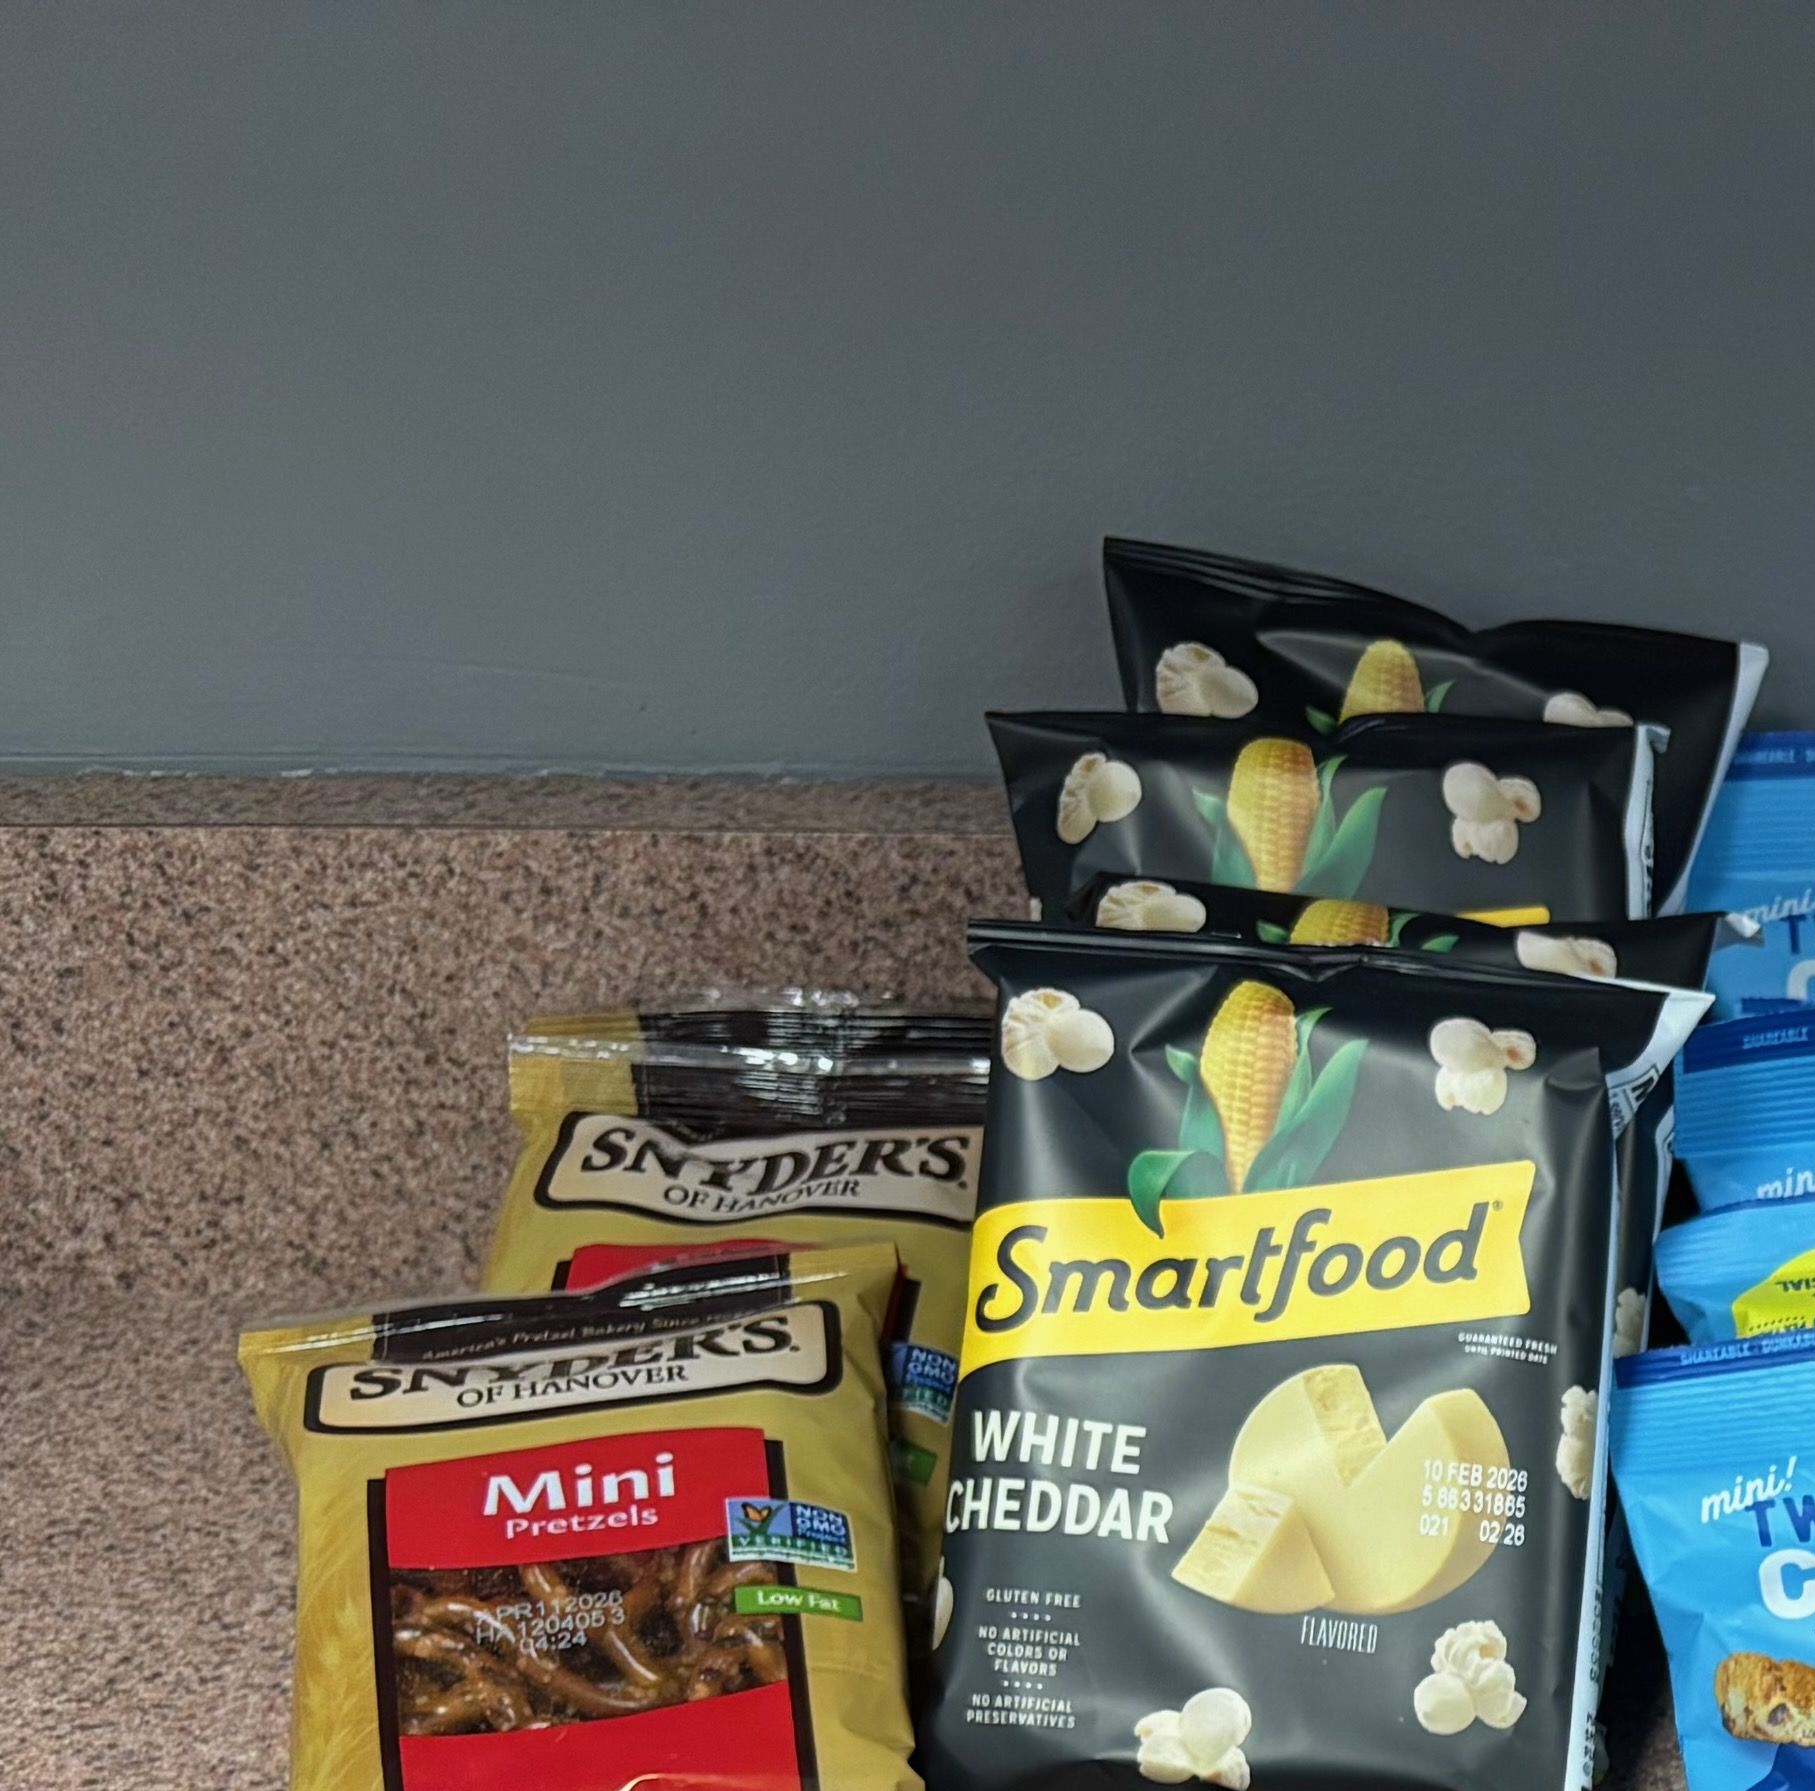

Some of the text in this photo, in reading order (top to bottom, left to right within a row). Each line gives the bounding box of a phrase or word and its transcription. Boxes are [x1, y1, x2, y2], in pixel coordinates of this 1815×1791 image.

[665, 1178, 860, 1212] OF HANOVER
[457, 1365, 689, 1408] OF HANOVER
[973, 1410, 1147, 1475] WHITE
[483, 1451, 675, 1516] Mini
[1701, 1456, 1797, 1525] mini!
[506, 1503, 658, 1539] Pretzels
[795, 1503, 841, 1523] NON
[945, 1479, 1174, 1544] CHEDDAR
[757, 1589, 840, 1612] Low Fat
[986, 1589, 1081, 1608] GLUTEN FREE
[1301, 1617, 1379, 1655] FLAVORED
[995, 1659, 1057, 1678] FLAVORS
[966, 1709, 1076, 1729] PRESERVATIVES
